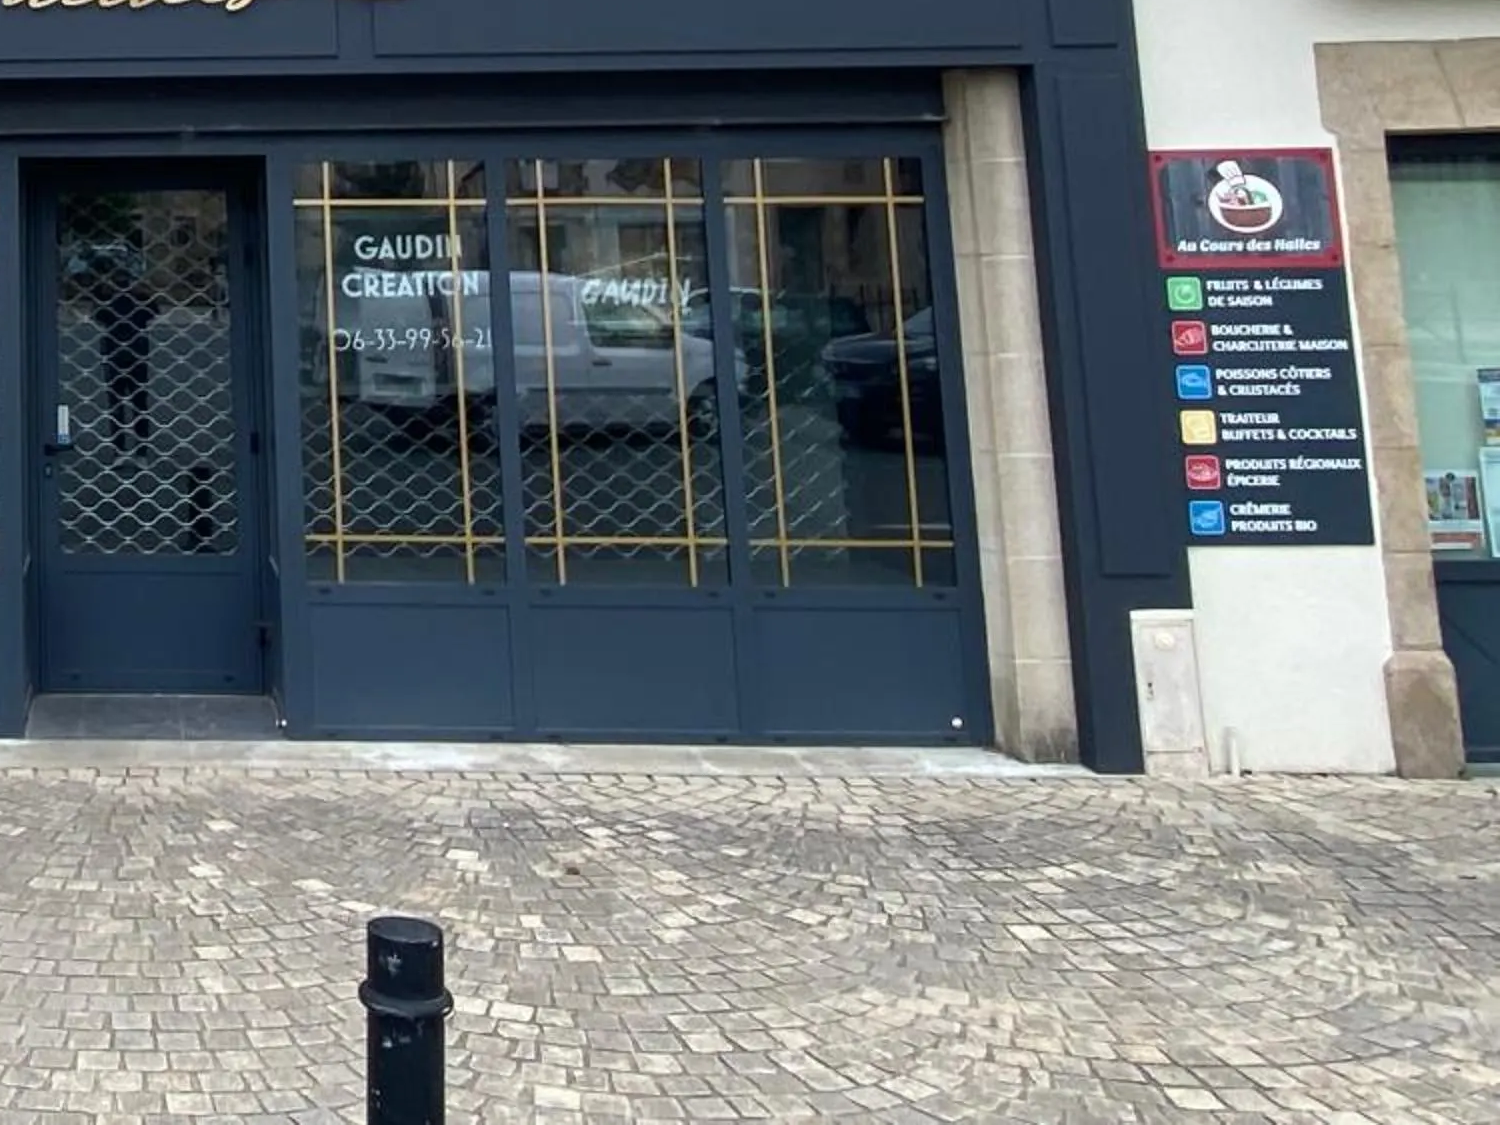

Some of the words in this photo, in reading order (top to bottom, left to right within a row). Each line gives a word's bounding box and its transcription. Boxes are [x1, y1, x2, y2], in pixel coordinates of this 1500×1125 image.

[1177, 239, 1197, 252] Au
[1200, 239, 1243, 252] Cours
[1246, 237, 1271, 252] des
[1274, 238, 1320, 252] Halles
[1206, 279, 1249, 291] FRUITS
[1253, 280, 1262, 290] &
[1207, 296, 1227, 307] DE
[1228, 295, 1273, 307] SAISON
[1211, 324, 1281, 336] BOUCHERIE
[1212, 340, 1297, 352] CHARCUTERIE
[1298, 339, 1349, 350] MAISON
[1215, 368, 1277, 380] POISSONS
[1217, 385, 1227, 395] &
[1220, 412, 1280, 424] TRAITEUR
[1221, 429, 1275, 440] BUFFETS
[1289, 428, 1357, 439] COCKTAILS
[1225, 459, 1287, 470] PRODUITS
[1231, 520, 1293, 532] PRODUITS
[1295, 521, 1317, 532] BIO
